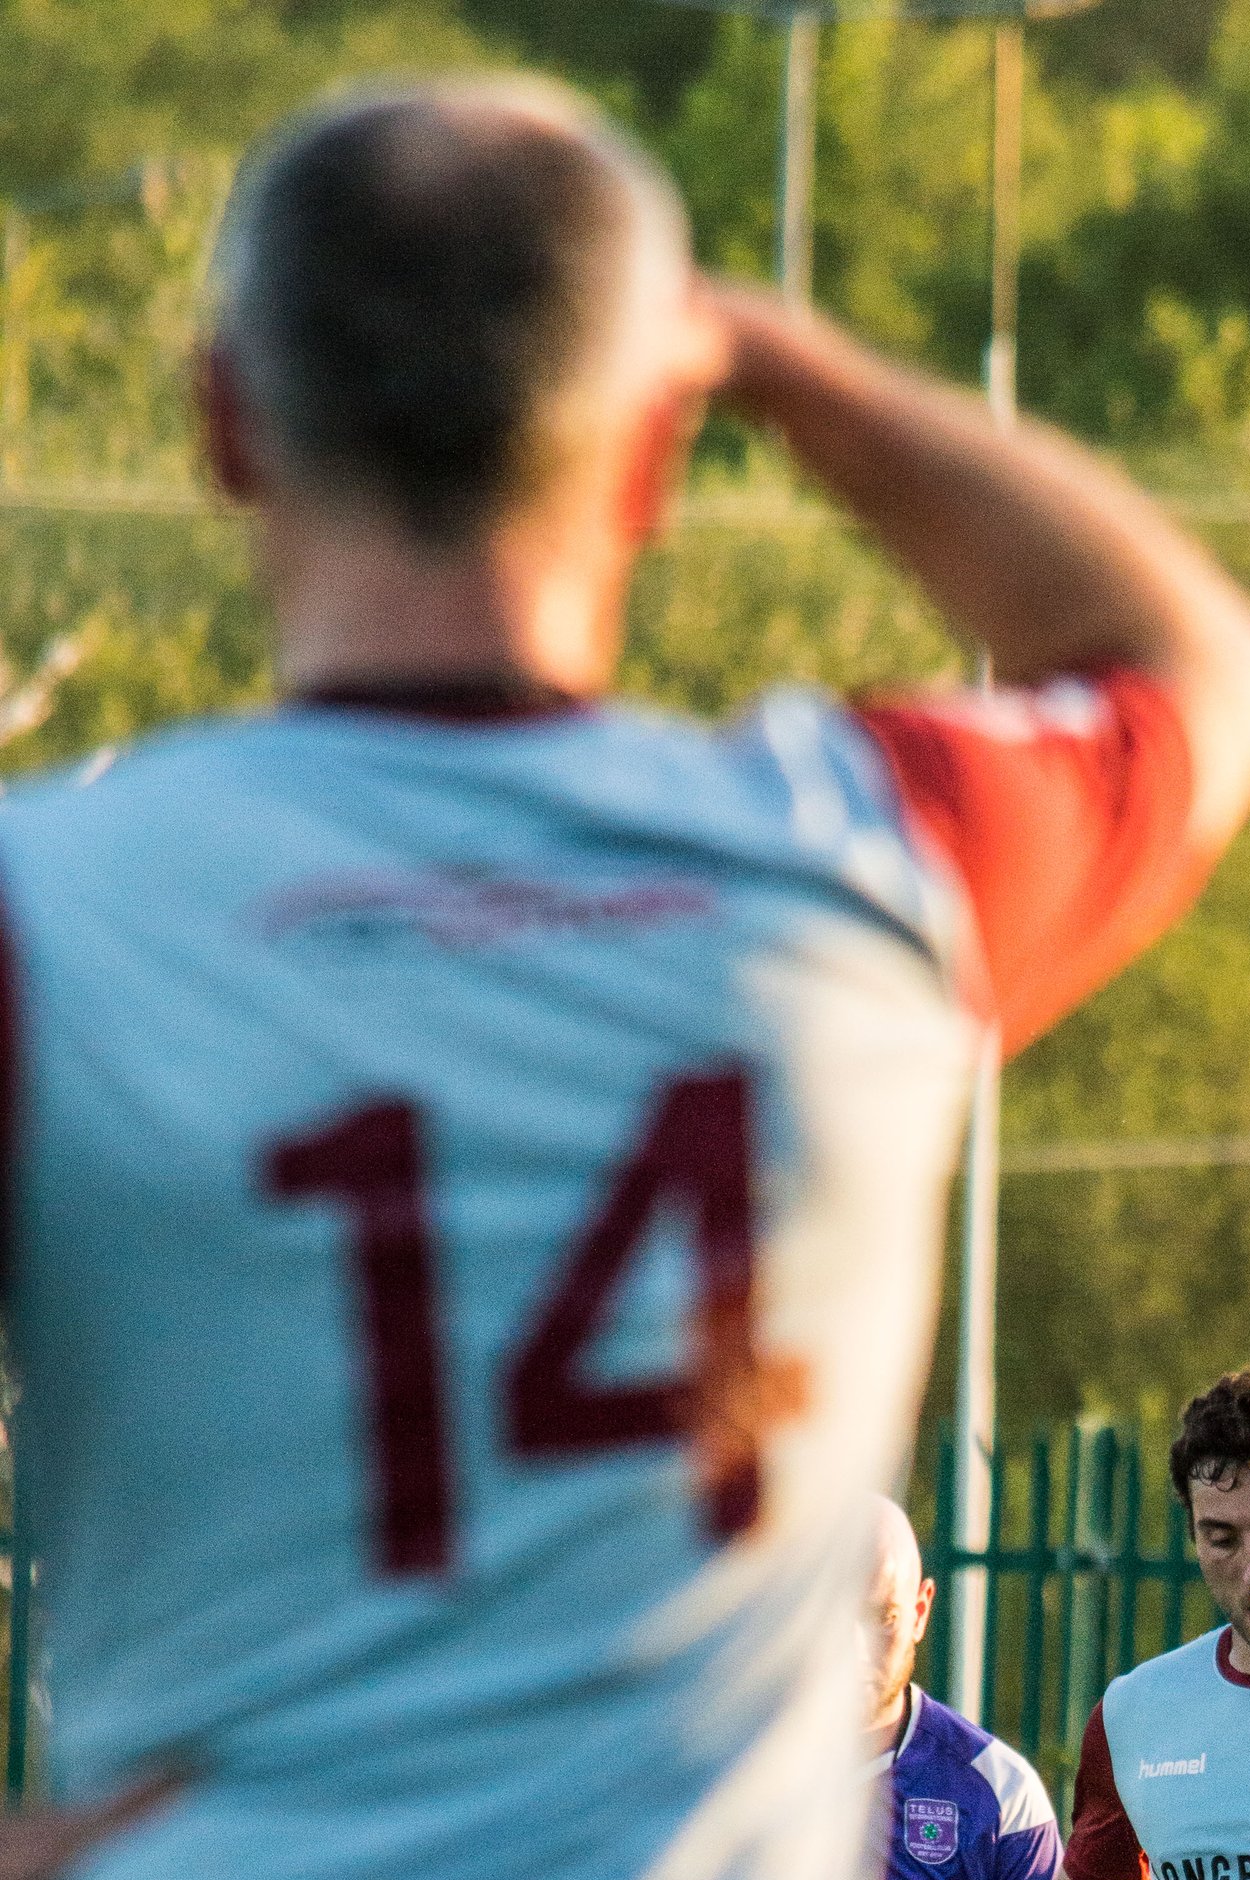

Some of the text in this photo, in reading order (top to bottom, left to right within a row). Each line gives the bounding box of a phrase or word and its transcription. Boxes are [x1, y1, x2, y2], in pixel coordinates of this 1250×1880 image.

[255, 1062, 808, 1582] 14
[1138, 1752, 1206, 1779] hummel
[909, 1804, 954, 1815] TELUS
